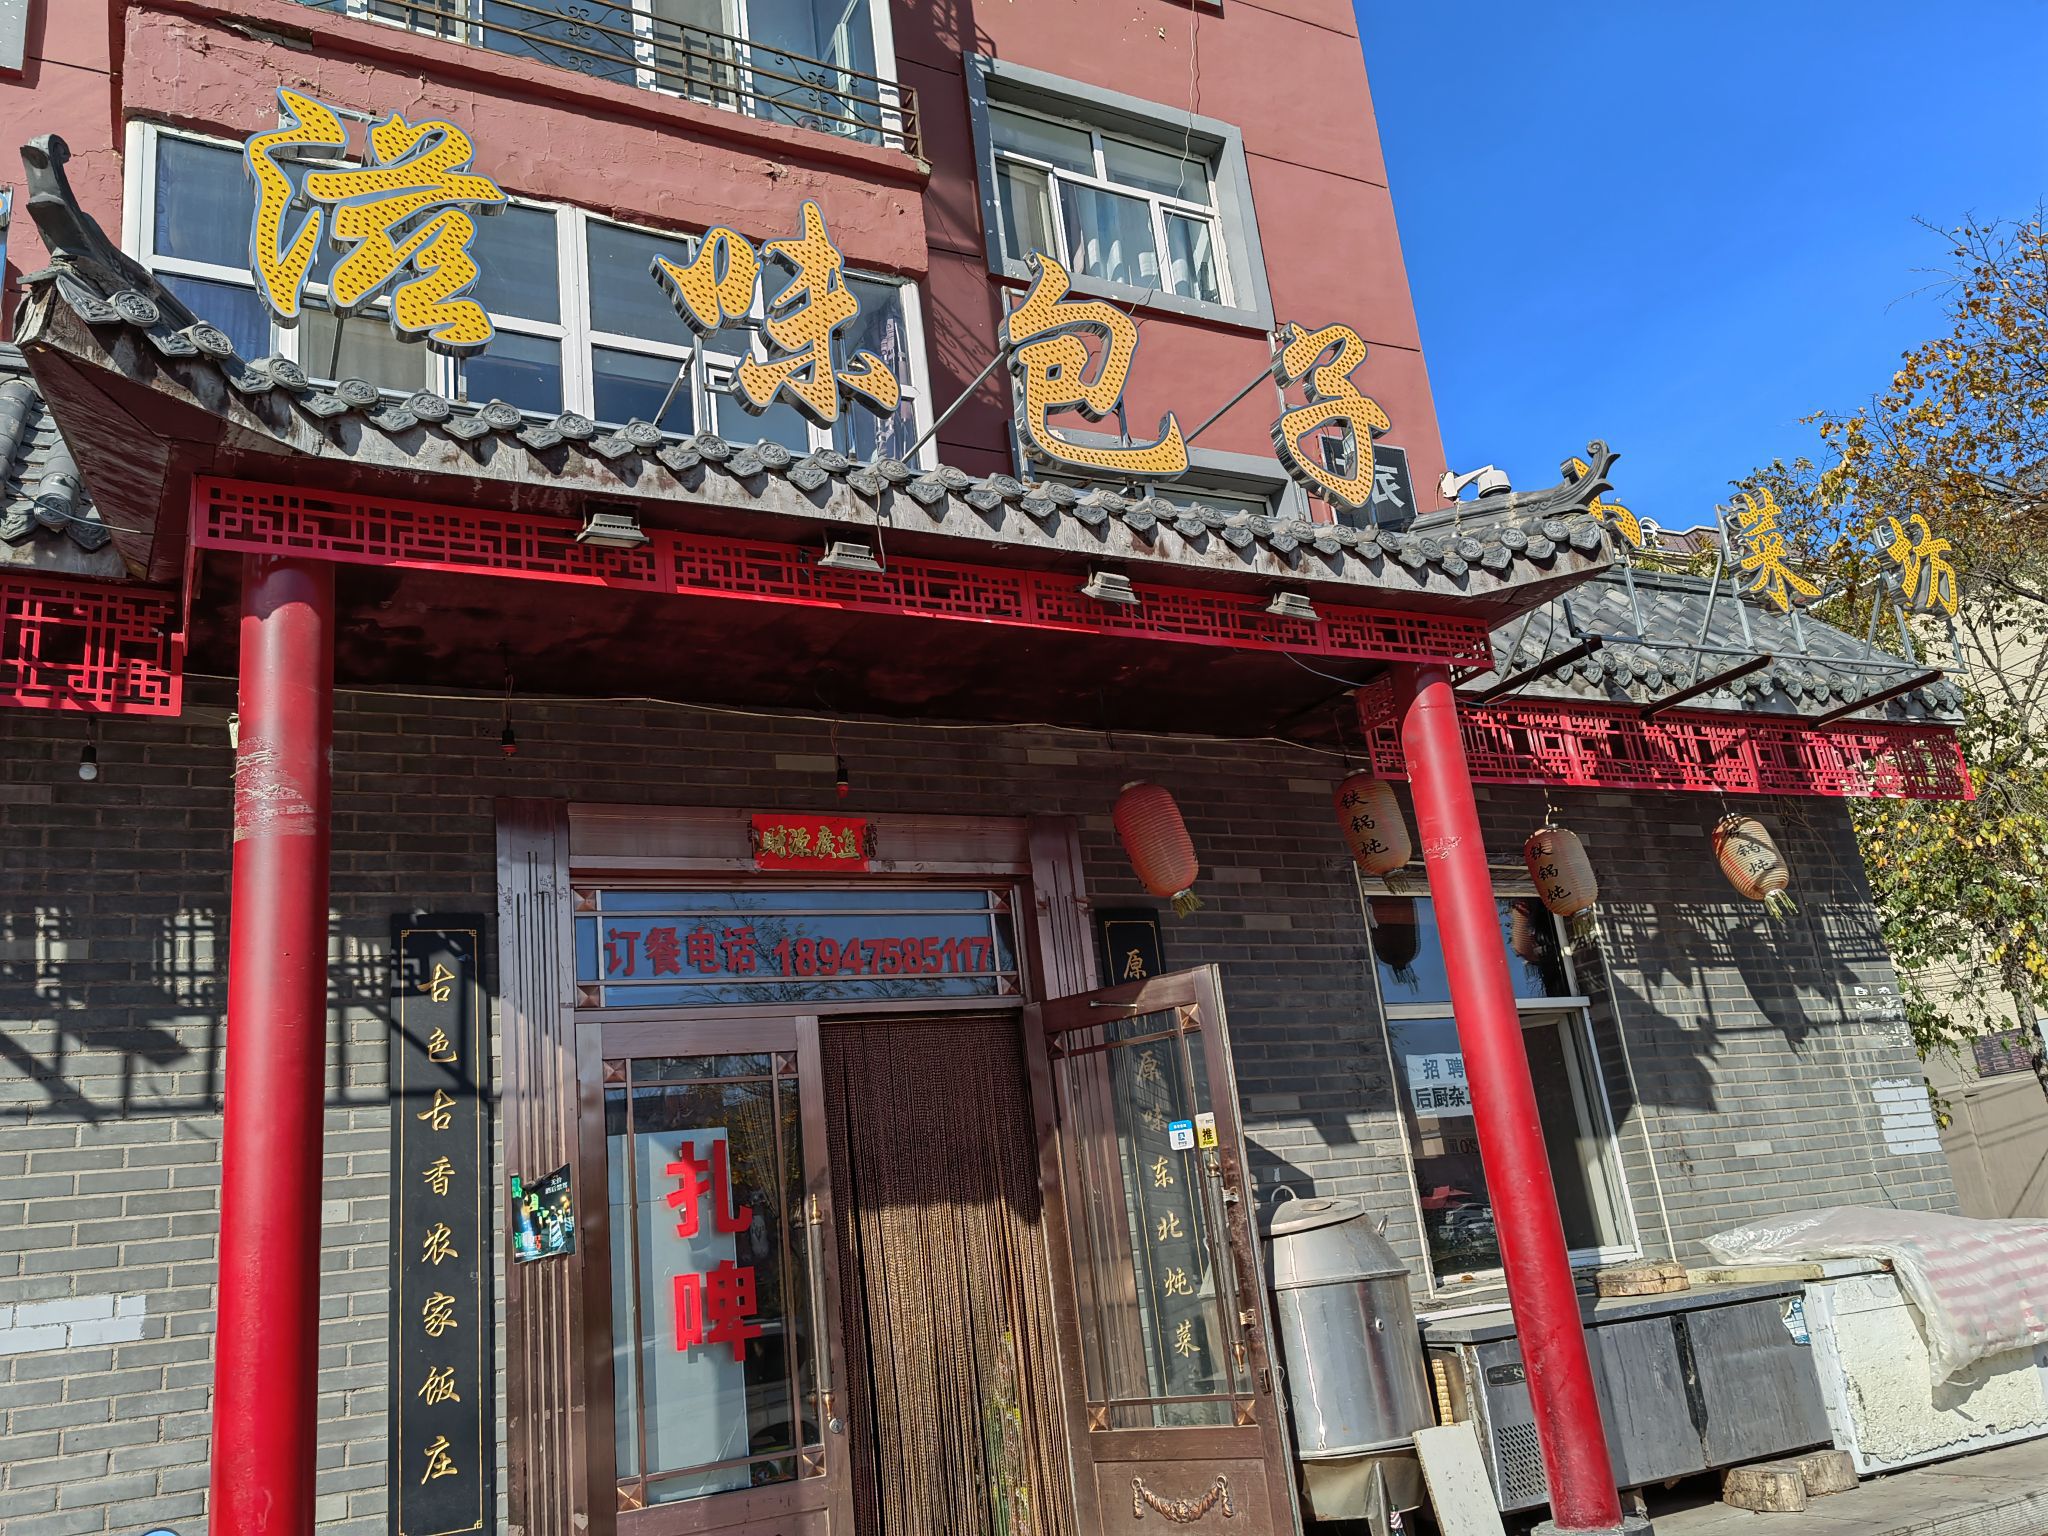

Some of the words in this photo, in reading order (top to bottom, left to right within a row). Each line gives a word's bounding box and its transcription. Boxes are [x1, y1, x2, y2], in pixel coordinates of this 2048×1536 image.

[1341, 790, 1389, 857] 铁锅炖
[1529, 842, 1571, 902] 铁锅炖
[604, 926, 757, 977] 订餐电话
[773, 936, 992, 977] 18947585117
[1422, 1057, 1464, 1079] 招聘
[1202, 1128, 1213, 1140] 推
[417, 962, 461, 1486] 古色古香农家饭庄
[666, 1140, 763, 1362] 扎啤
